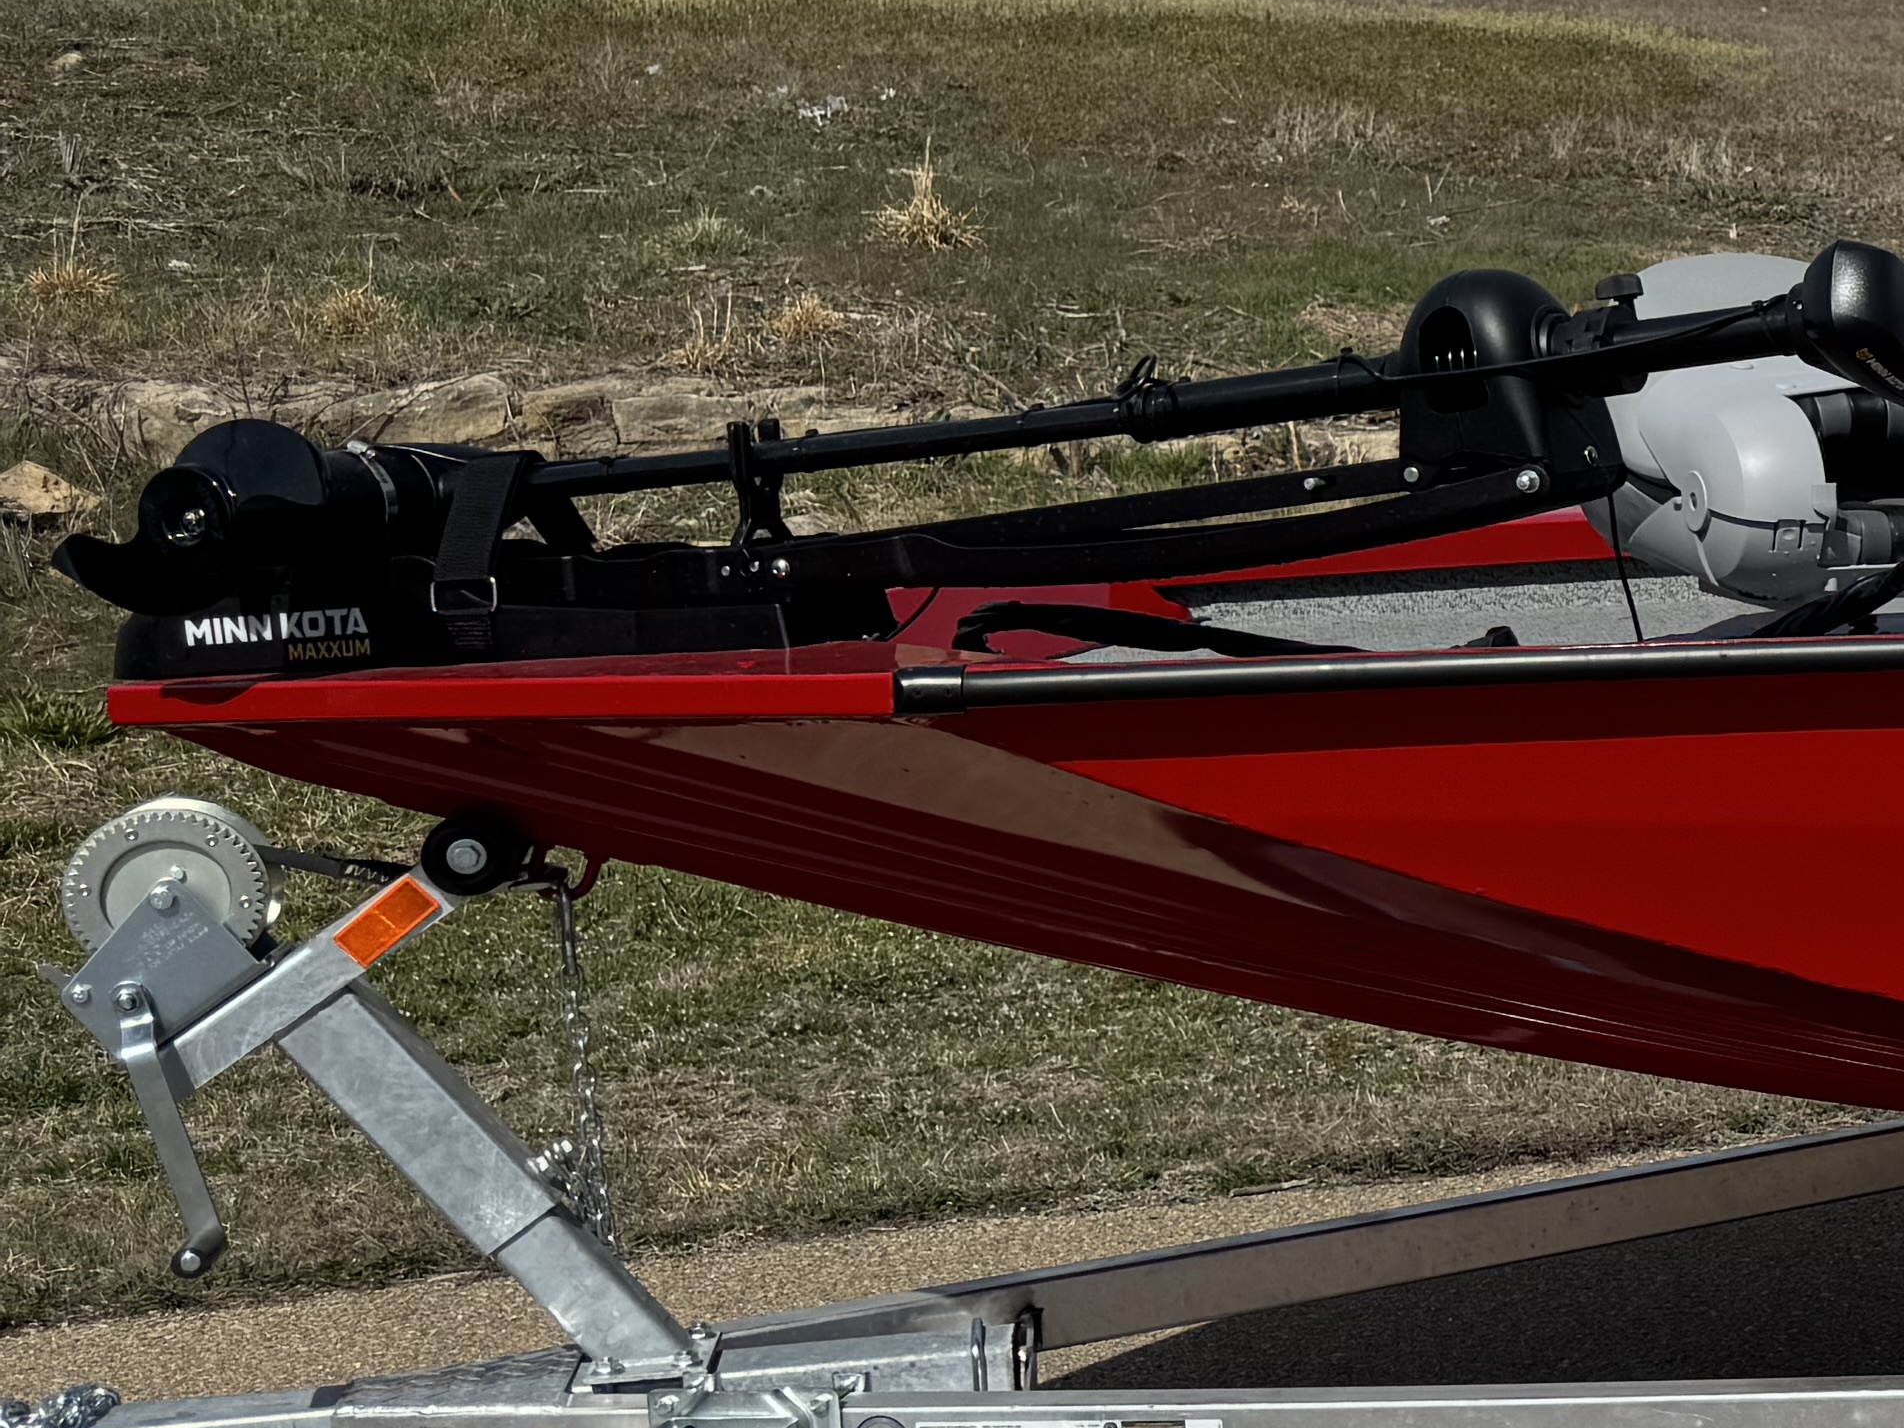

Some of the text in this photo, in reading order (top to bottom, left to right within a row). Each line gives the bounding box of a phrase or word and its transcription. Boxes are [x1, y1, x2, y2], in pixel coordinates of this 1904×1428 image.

[184, 607, 369, 647] MINN KOTA
[287, 638, 371, 661] MAXXUM
